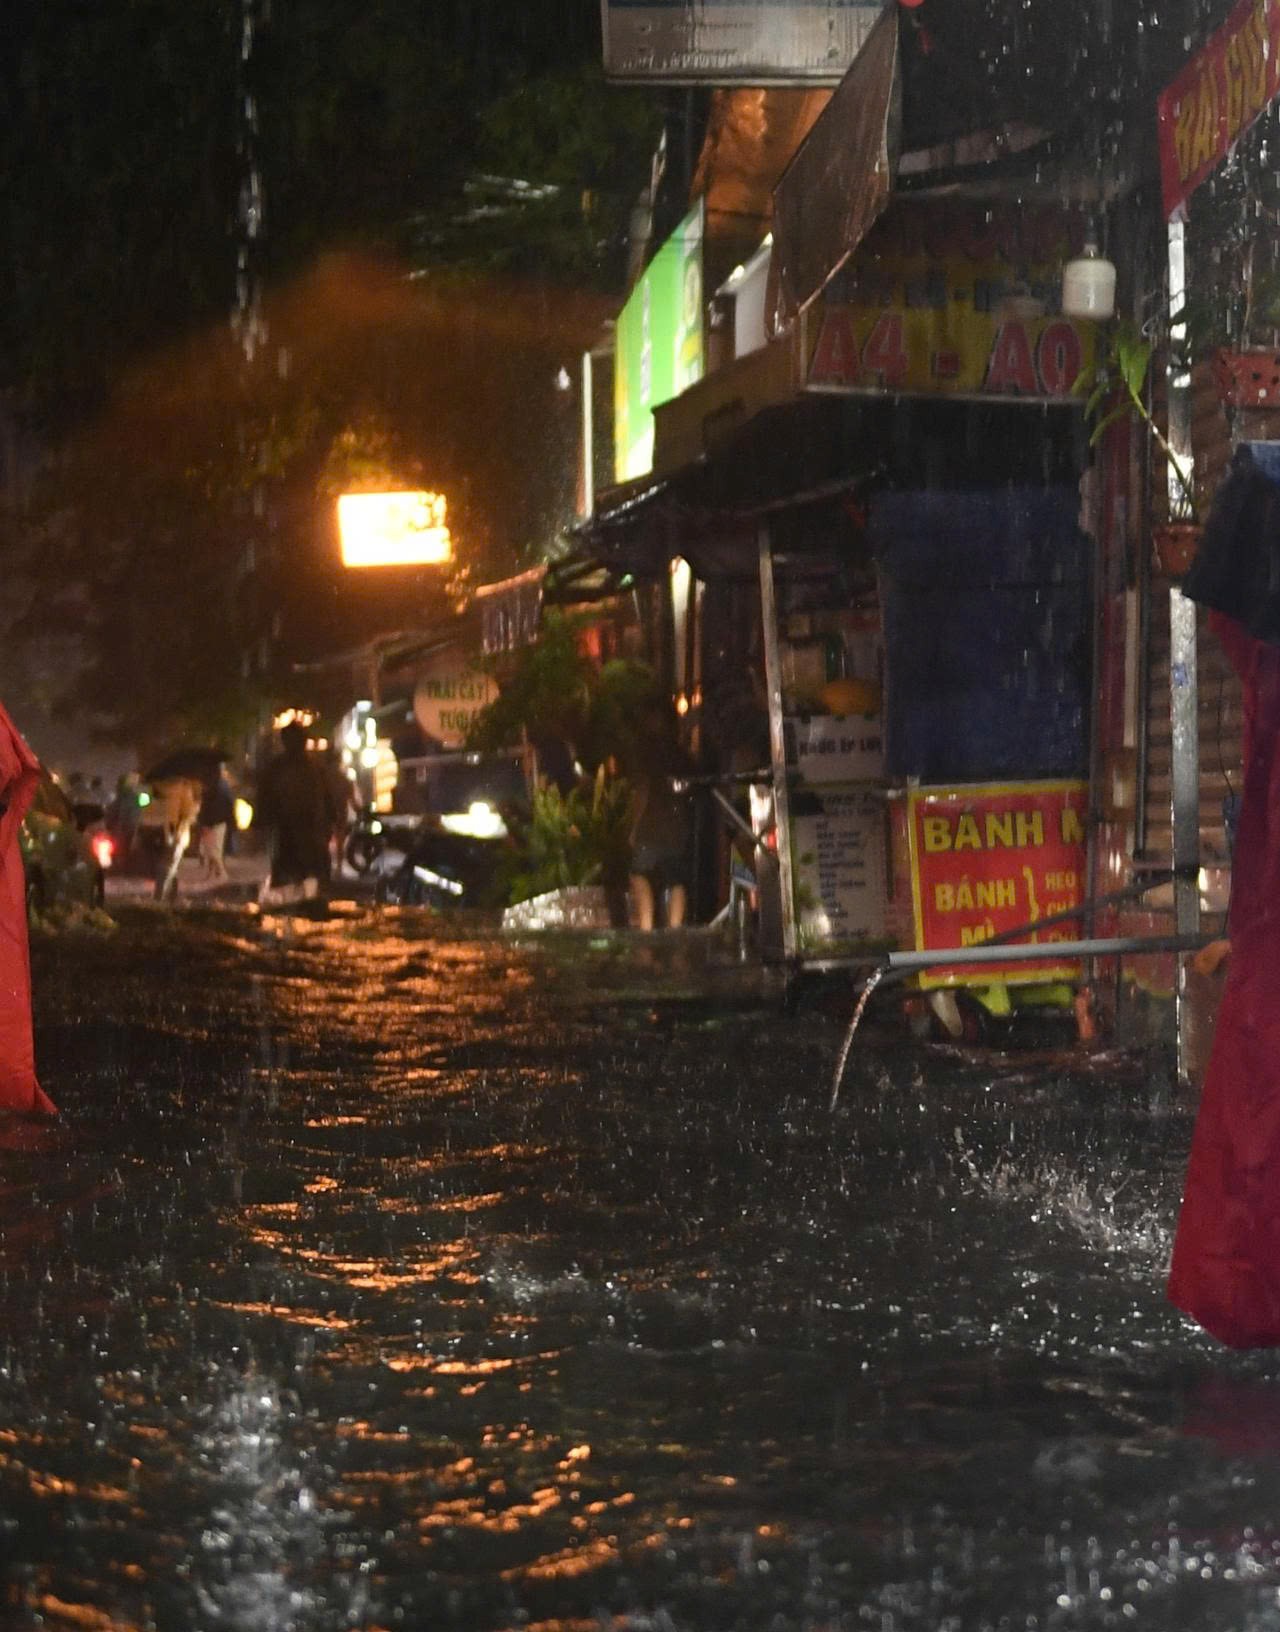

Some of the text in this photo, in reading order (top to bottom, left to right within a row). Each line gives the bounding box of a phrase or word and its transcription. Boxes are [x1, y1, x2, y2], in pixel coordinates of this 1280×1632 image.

[810, 309, 907, 390] A4
[923, 804, 1044, 853] BÁNH
[934, 869, 1077, 913] BÁNH HEO
